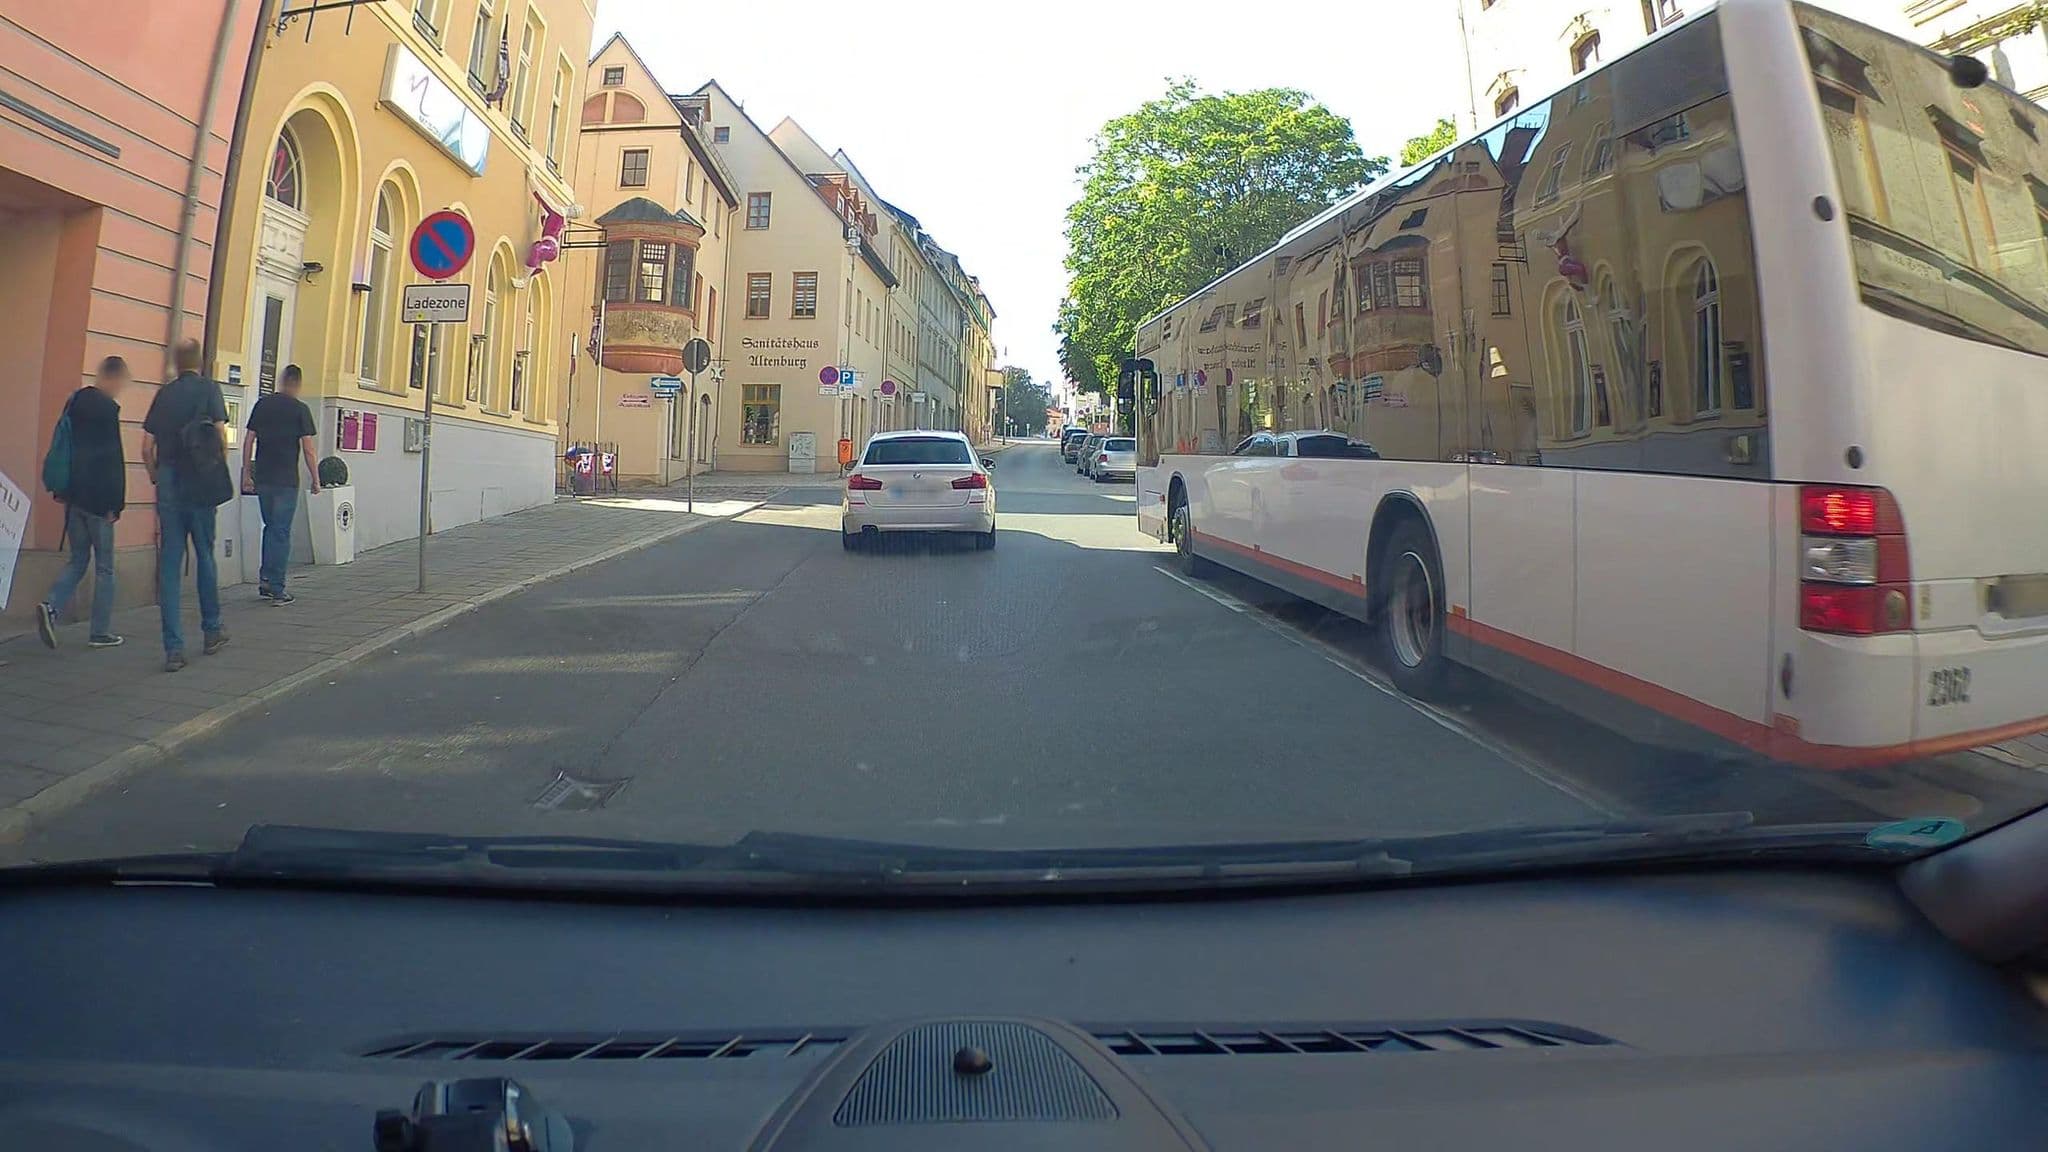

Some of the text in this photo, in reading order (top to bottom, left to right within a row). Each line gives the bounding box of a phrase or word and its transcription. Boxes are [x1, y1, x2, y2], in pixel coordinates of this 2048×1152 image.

[407, 296, 466, 310] Ladezone
[741, 337, 819, 351] Sanitätshaus
[748, 355, 807, 369] Altenburg
[842, 372, 852, 384] P
